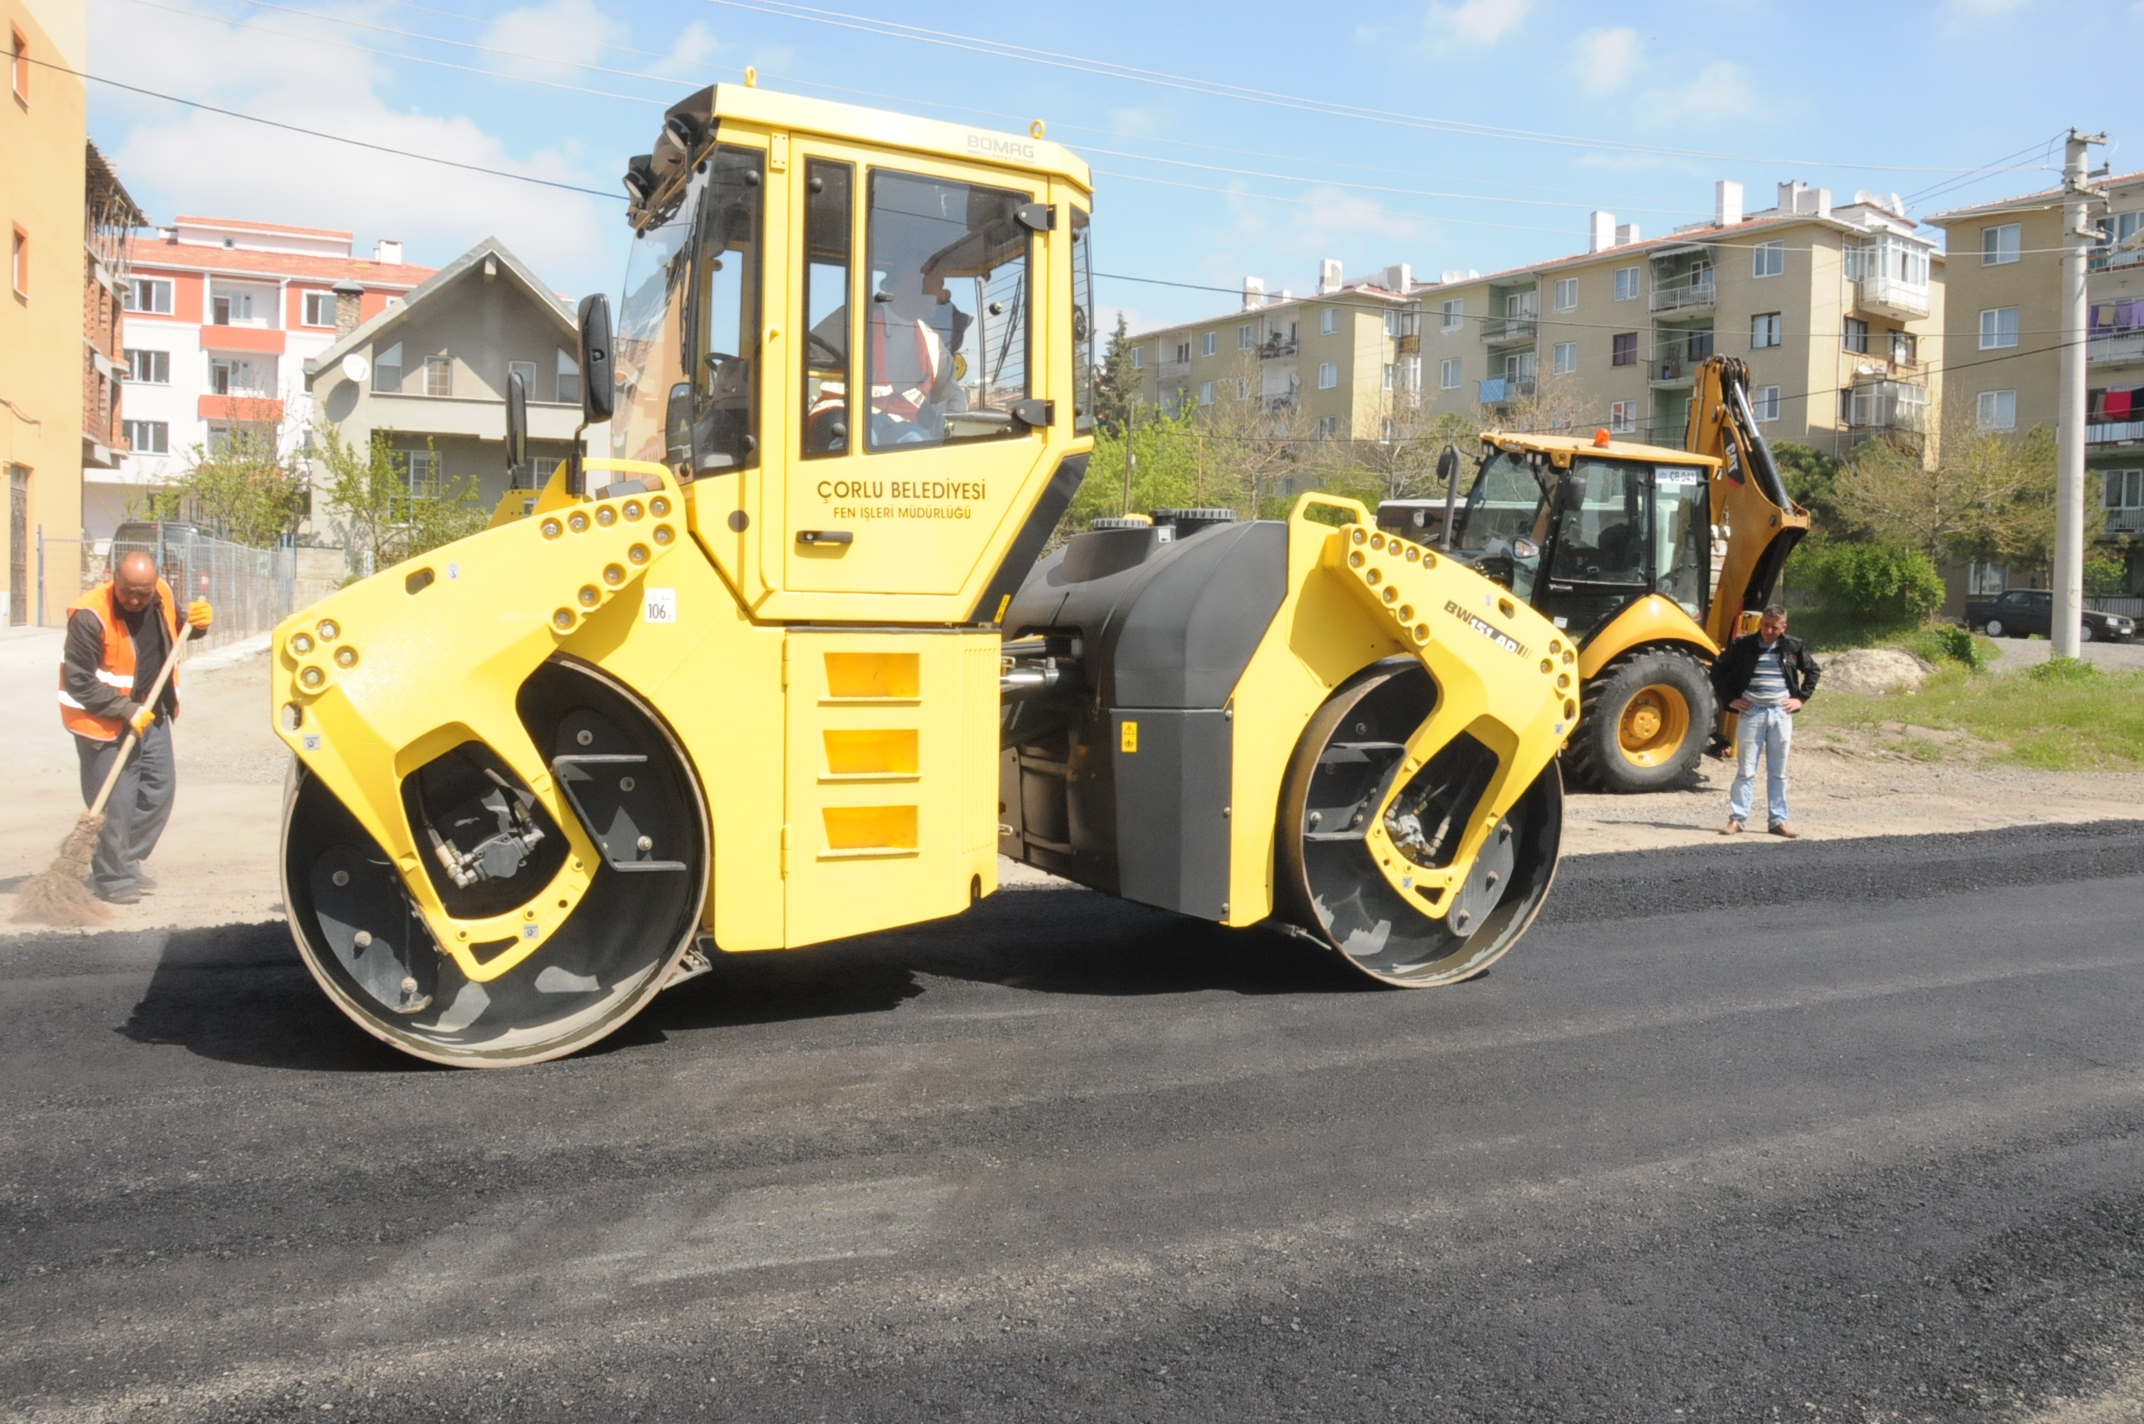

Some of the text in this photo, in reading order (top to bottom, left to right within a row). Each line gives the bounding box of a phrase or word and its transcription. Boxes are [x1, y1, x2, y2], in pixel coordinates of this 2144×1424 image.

[967, 134, 1034, 158] BOMAG
[1725, 442, 1739, 473] CAT
[817, 478, 986, 504] ÇORLU BELEDİYESİ
[833, 504, 971, 522] FEN İŞLERİ MÜDÜRLÜĞÜ
[648, 603, 666, 619] 106
[1469, 618, 1494, 638] 151
[1494, 634, 1518, 653] AD
